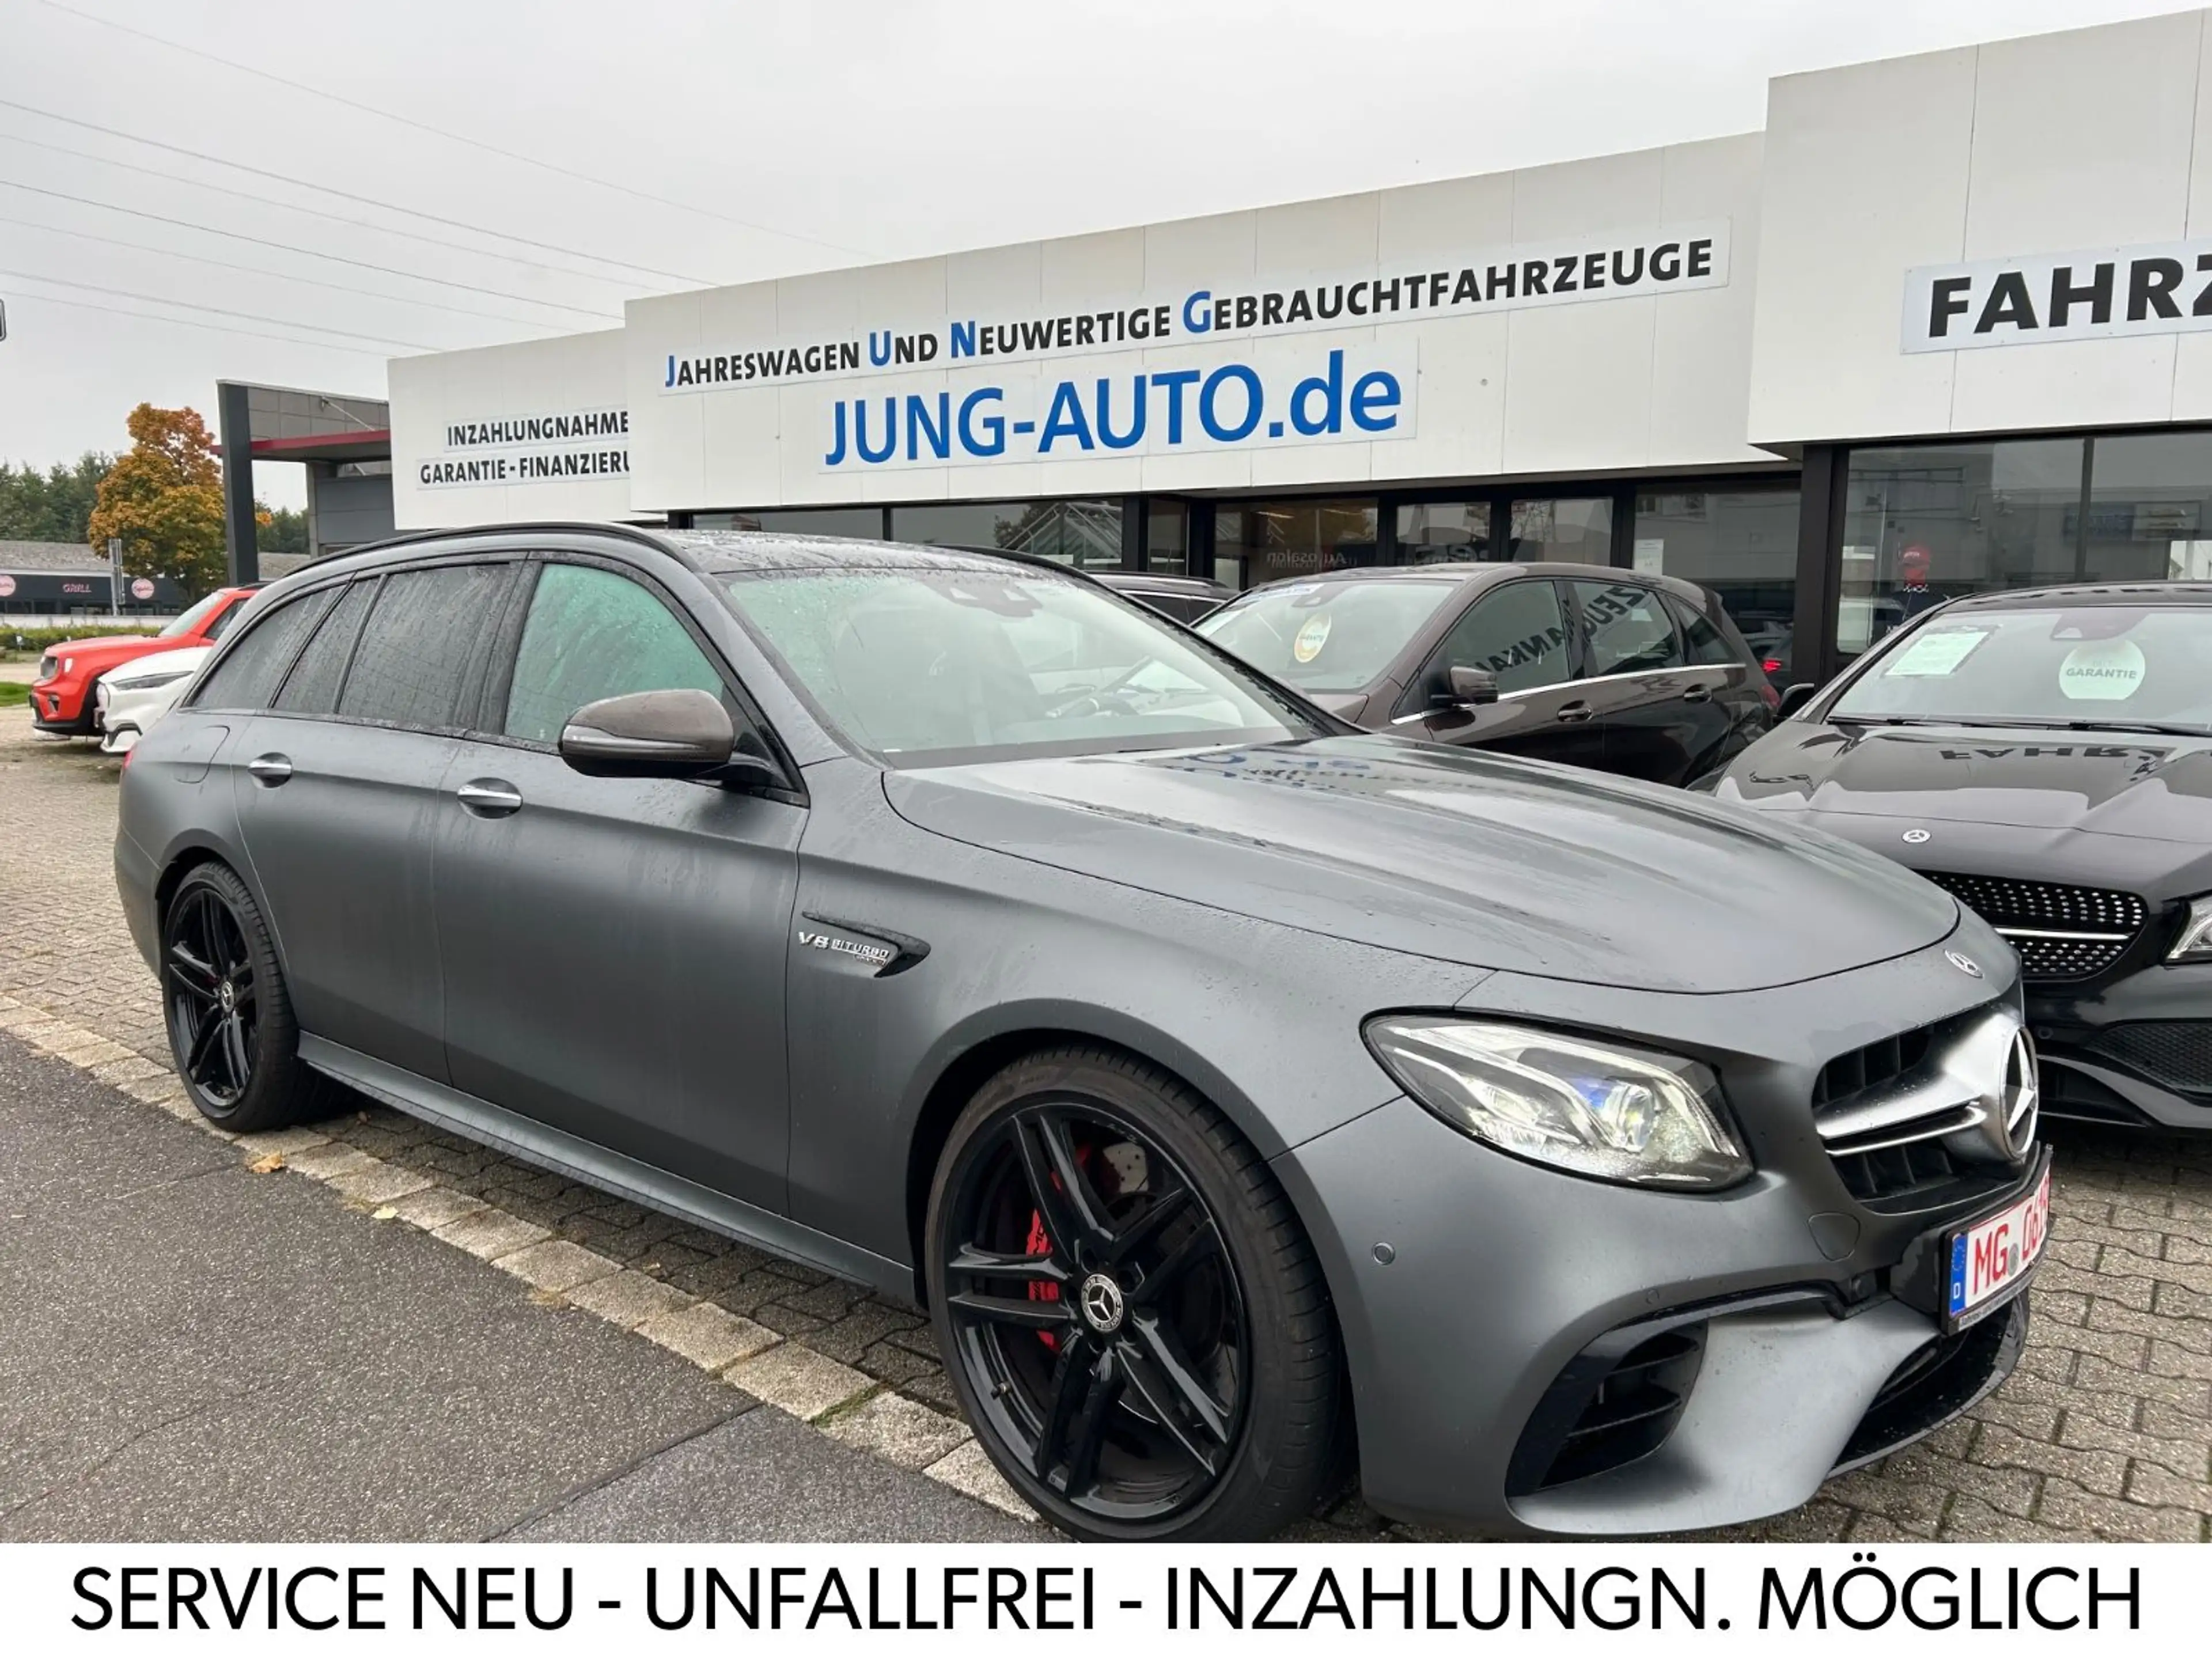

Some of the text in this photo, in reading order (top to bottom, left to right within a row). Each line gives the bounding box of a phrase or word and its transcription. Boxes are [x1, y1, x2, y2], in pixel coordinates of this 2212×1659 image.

[665, 238, 1712, 388] JAHRESWAGEN UND NEUWERTIGE GEBRAUCHTFAHRZEUGE
[825, 350, 1402, 465] JUNG-AUTO.de
[448, 411, 628, 446] INZAHLUNGNAHME
[2066, 668, 2138, 679] GARANTIE
[798, 931, 830, 949] V8
[1974, 1223, 2009, 1295] MG
[1953, 1283, 1961, 1300] D
